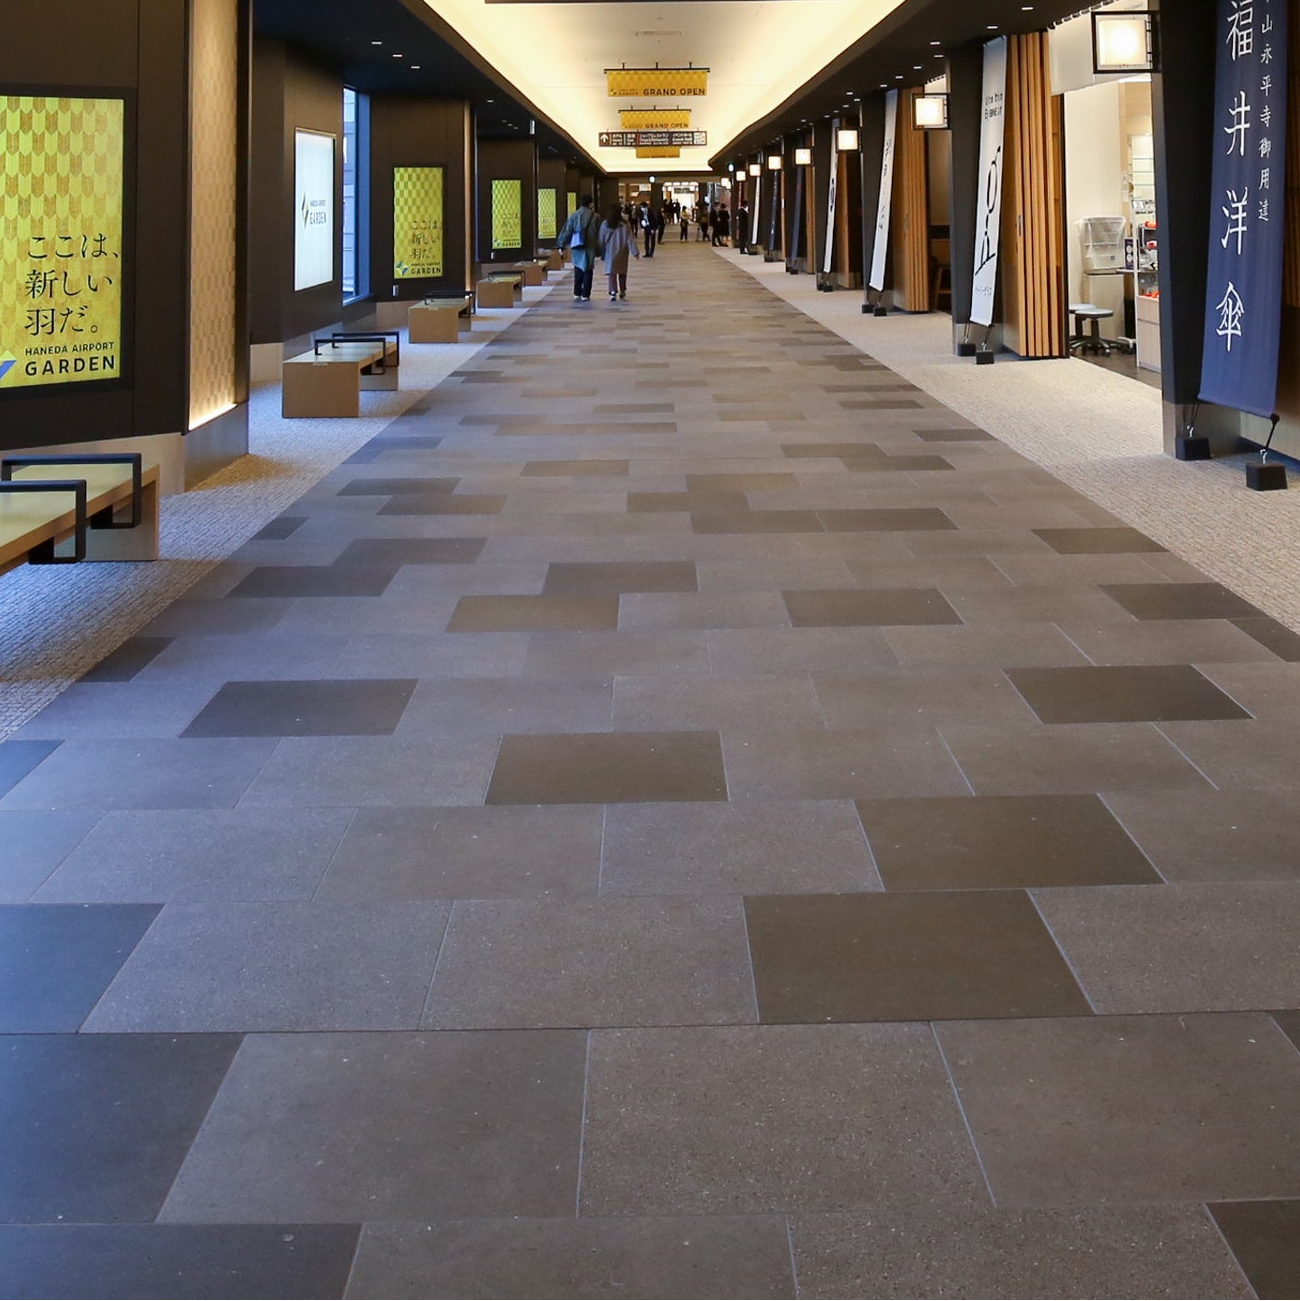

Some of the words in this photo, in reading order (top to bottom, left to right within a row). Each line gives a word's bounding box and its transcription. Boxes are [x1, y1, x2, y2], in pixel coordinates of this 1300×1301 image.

[643, 88, 676, 96] GRAND
[679, 88, 706, 96] OPEN
[27, 233, 119, 259] ここは、
[411, 267, 441, 275] GARDEN
[24, 268, 113, 299] 新しい
[24, 304, 99, 336] 羽だ。
[25, 344, 68, 356] HANEDA
[72, 341, 115, 353] AIRPORT
[25, 355, 116, 377] GARDEN
